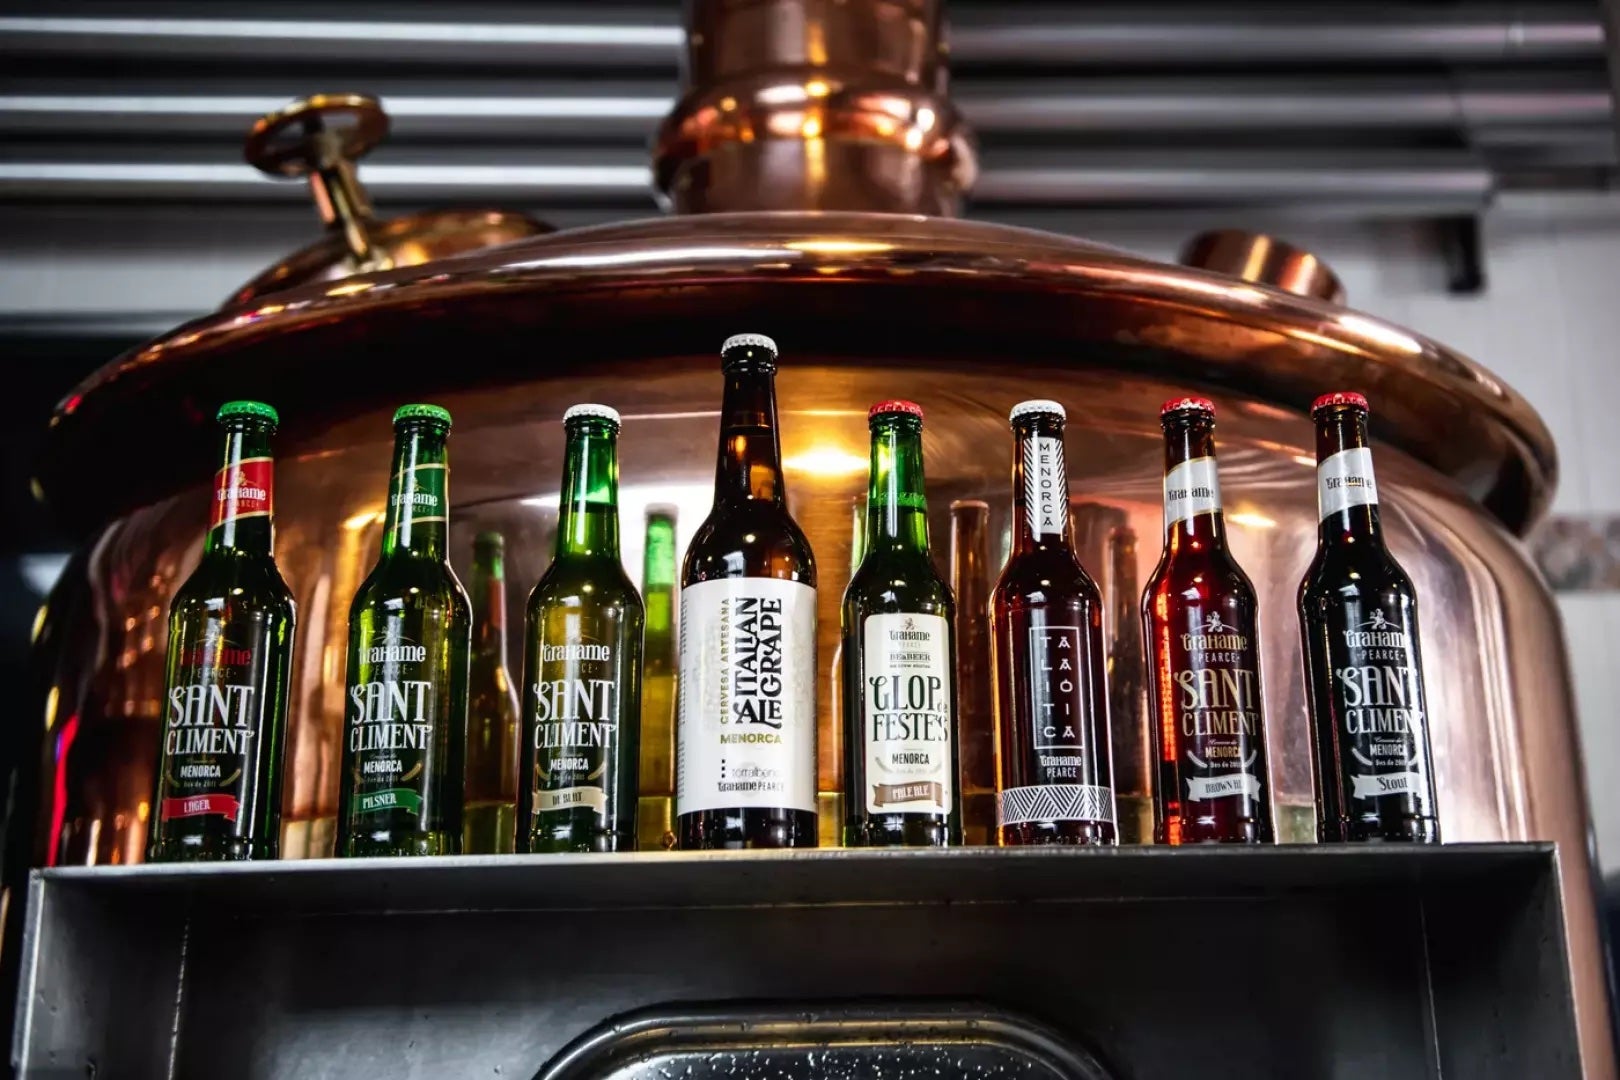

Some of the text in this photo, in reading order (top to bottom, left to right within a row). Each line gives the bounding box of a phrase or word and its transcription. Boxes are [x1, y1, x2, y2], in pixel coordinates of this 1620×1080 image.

[217, 487, 266, 501] Graame
[1039, 443, 1053, 526] MENORCA
[391, 492, 438, 507] Graame
[543, 643, 611, 663] Graame
[720, 598, 730, 725] CERVESA ARTESANA
[735, 597, 758, 697] ITALIAN
[760, 598, 782, 698] GRAPE
[1198, 652, 1237, 663] PEARCE
[1361, 650, 1400, 661] PEARCE
[532, 679, 615, 722] SANT
[869, 674, 941, 712] GLOP
[1173, 668, 1254, 710] SANT
[1336, 666, 1418, 708] SANT
[168, 684, 255, 728] SANT
[350, 680, 432, 726] SANT
[733, 698, 783, 730] ALE
[350, 723, 433, 753] CLIMENT
[534, 721, 616, 750] CLIMENT
[720, 733, 782, 744] MENORCA
[872, 712, 949, 742] FESTES
[1182, 711, 1259, 737] CLIMENT
[166, 727, 255, 756] CLIMENT
[180, 764, 221, 778] MENORCA
[363, 759, 403, 774] MENORCA
[550, 757, 589, 771] MENORCA
[892, 753, 930, 765] MENORCA
[1046, 767, 1077, 778] PEARCE
[1377, 776, 1408, 791] Stout
[362, 792, 397, 810] PILSNER
